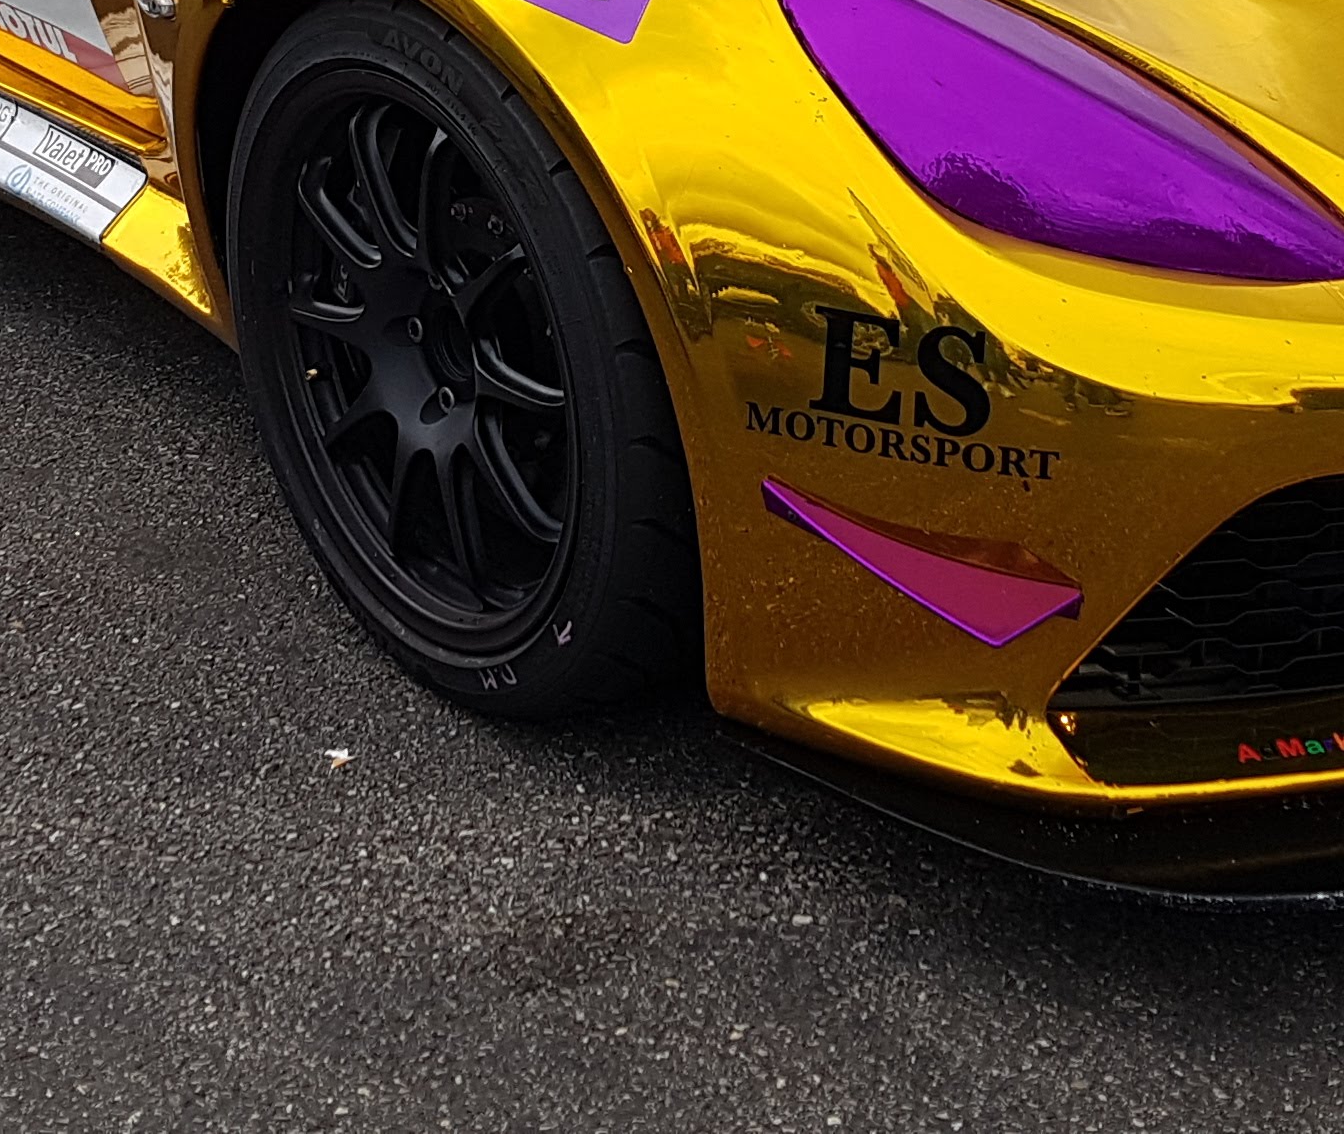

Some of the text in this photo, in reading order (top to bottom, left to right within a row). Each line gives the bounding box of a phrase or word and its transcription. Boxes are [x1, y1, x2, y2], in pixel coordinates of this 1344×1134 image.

[42, 131, 112, 176] Valet PRO
[808, 305, 991, 438] ES
[745, 401, 1061, 480] MOTORSPORT
